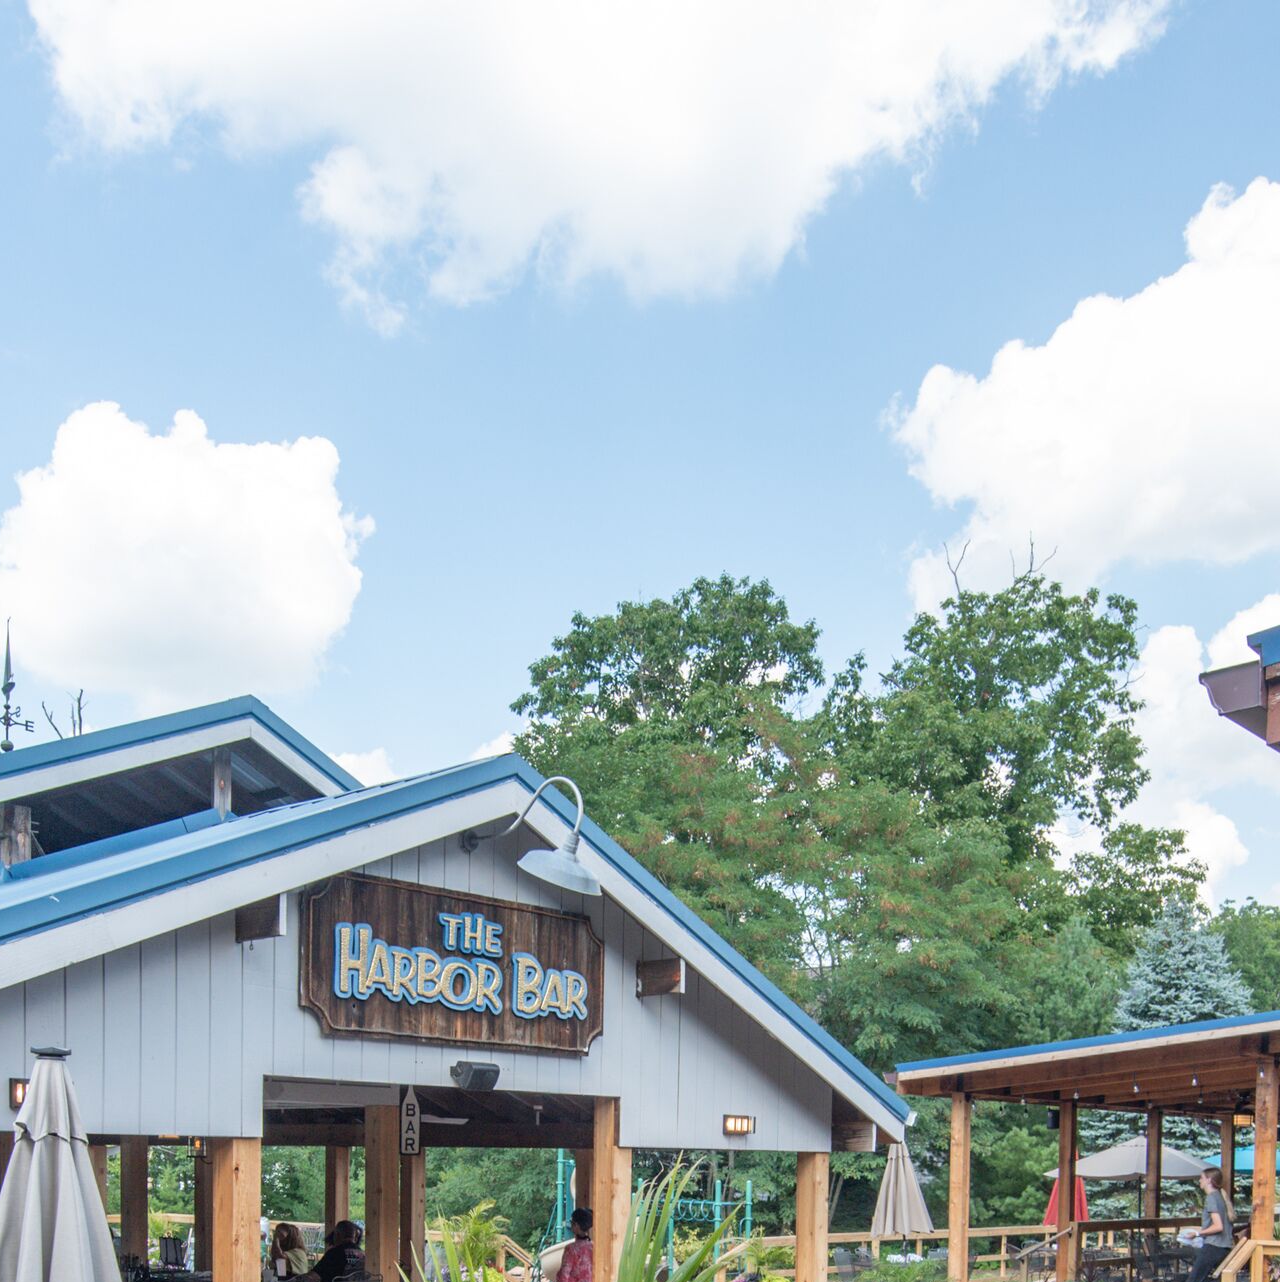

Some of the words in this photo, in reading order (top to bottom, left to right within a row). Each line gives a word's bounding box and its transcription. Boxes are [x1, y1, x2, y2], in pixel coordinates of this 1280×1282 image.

[439, 912, 504, 958] THE
[335, 922, 504, 1016] HARBOR
[512, 951, 588, 1020] BAR
[405, 1103, 416, 1151] BAR
